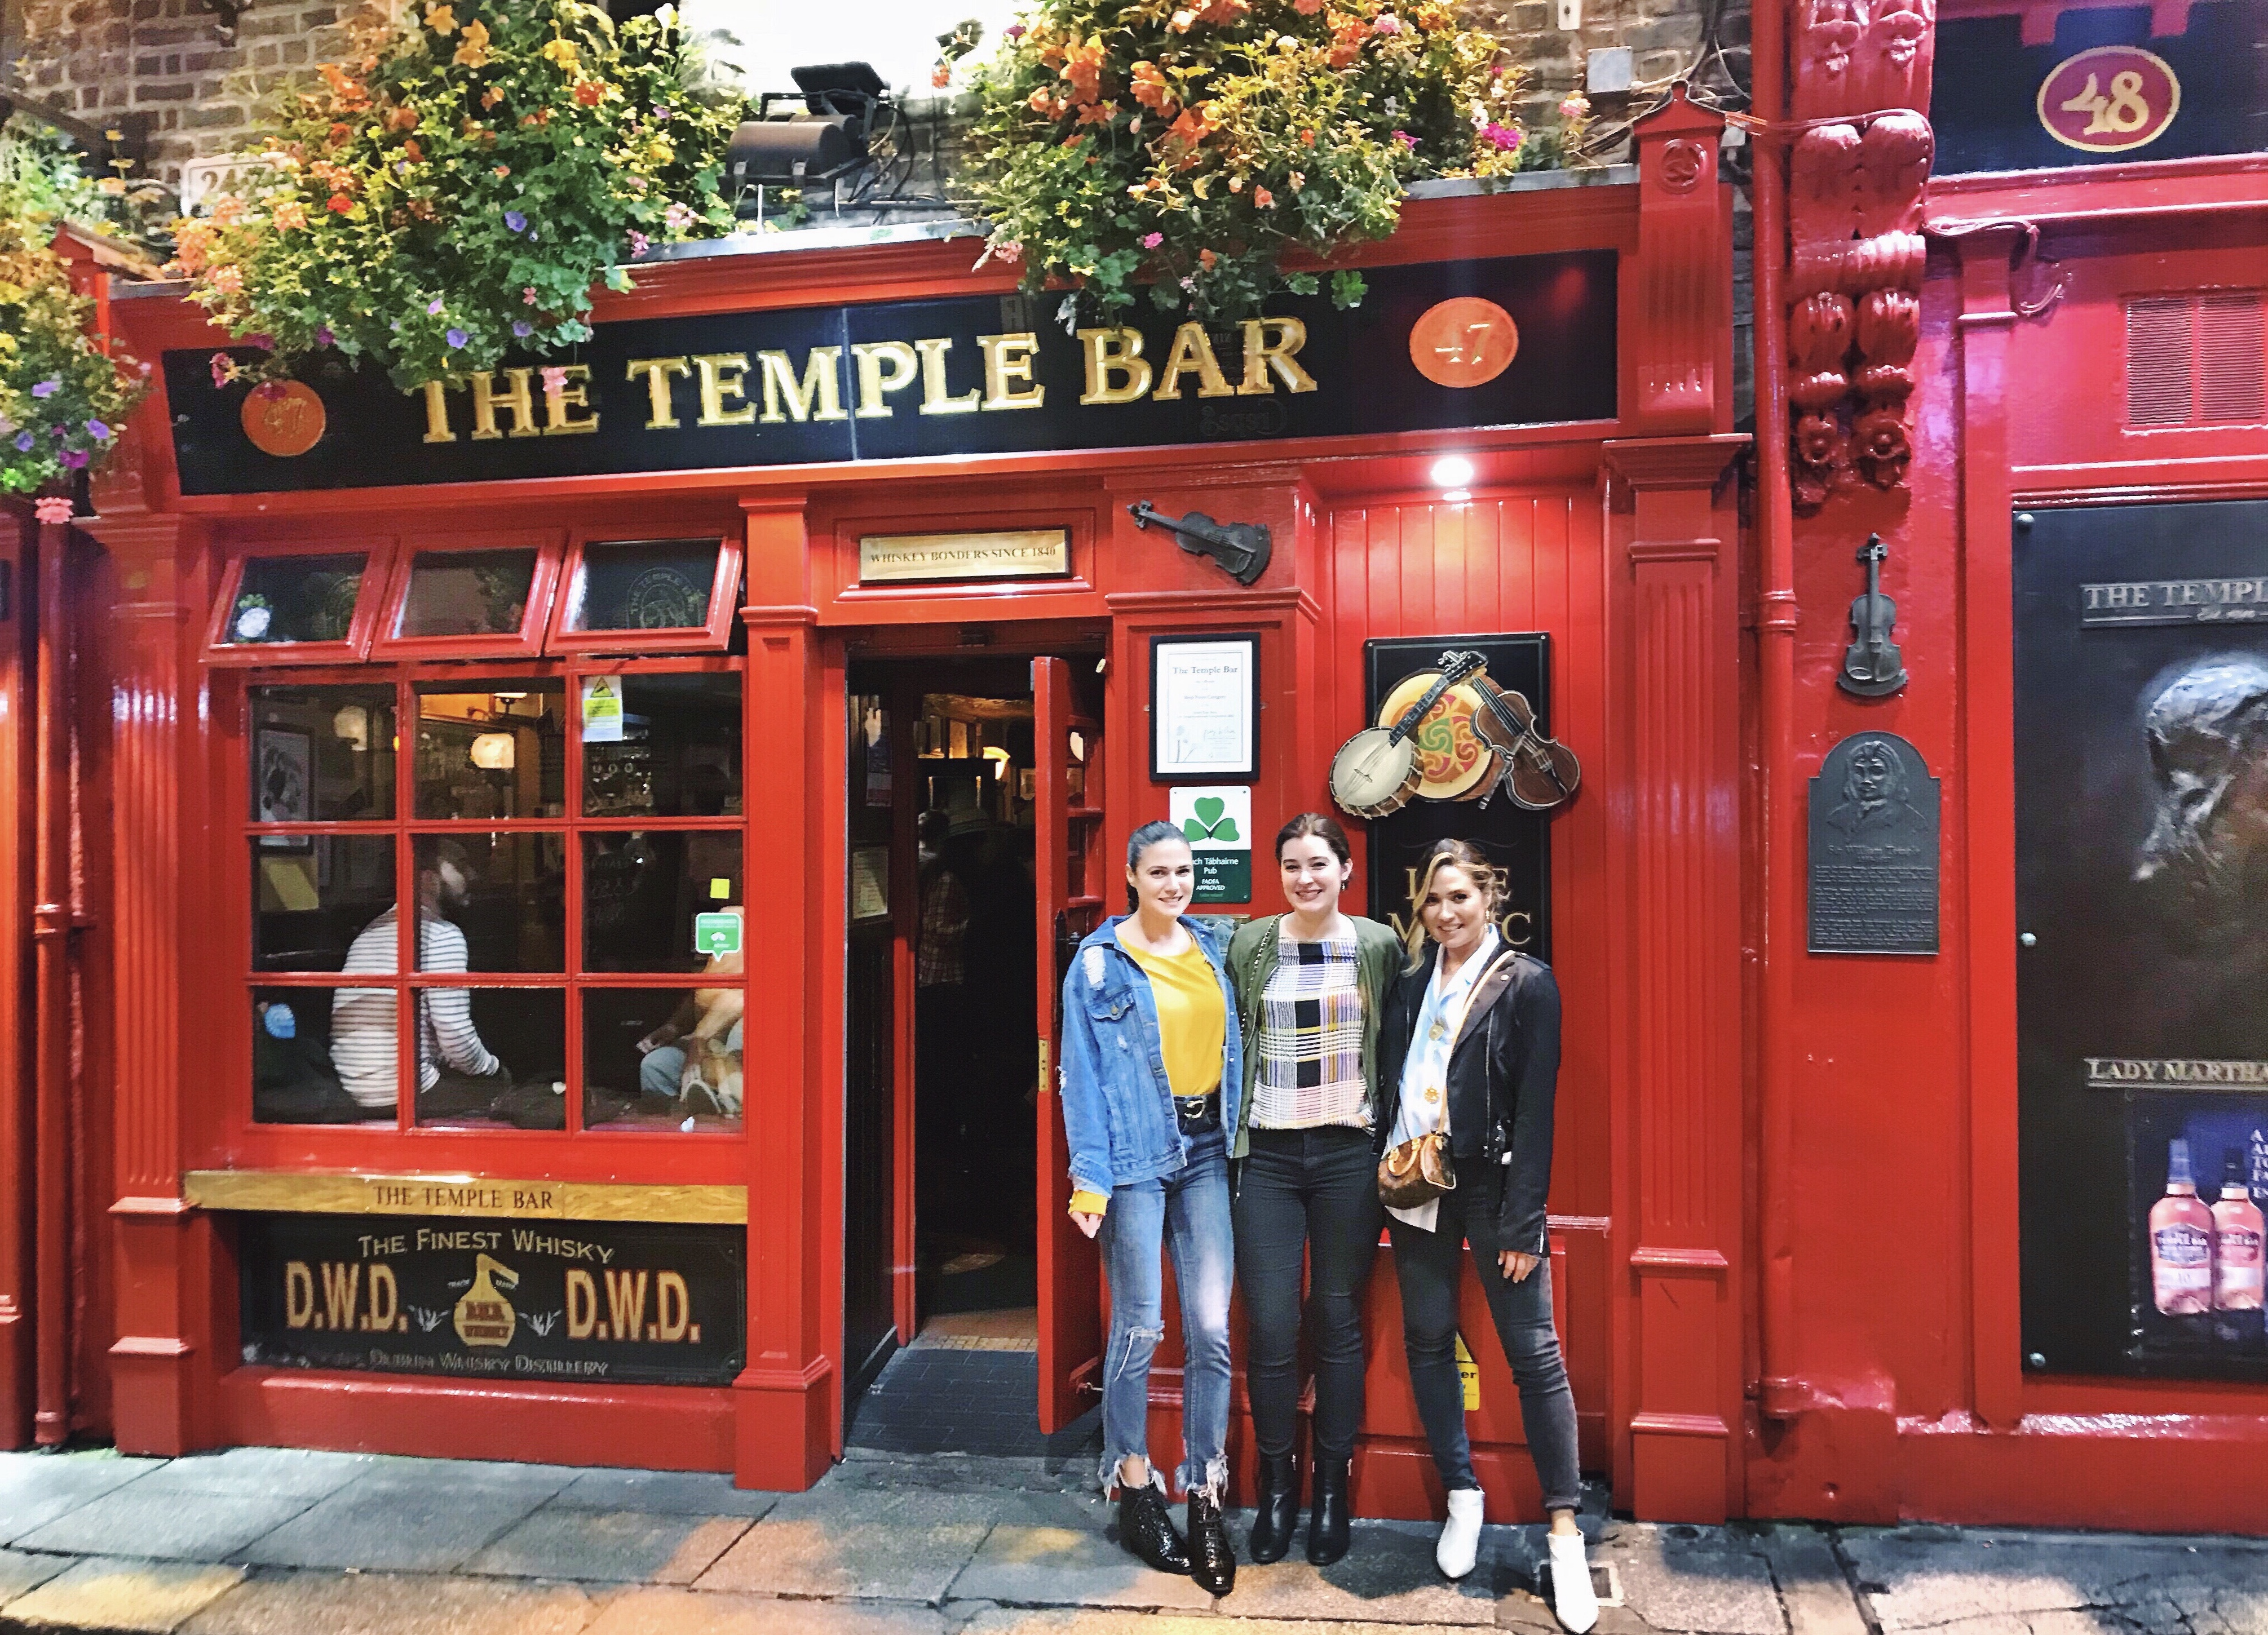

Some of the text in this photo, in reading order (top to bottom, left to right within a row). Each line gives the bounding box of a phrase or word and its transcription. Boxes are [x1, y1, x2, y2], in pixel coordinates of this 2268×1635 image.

[2061, 70, 2149, 136] 48
[1435, 319, 1494, 365] 47
[625, 332, 1046, 430] TEMPLE
[1076, 316, 1318, 405] BAR
[870, 546, 1056, 564] WHISKEY BONDERS SINCE 1840
[2085, 580, 2268, 609] THE TEMPL
[1191, 666, 1221, 676] Temple
[1203, 866, 1218, 875] Pub
[2087, 1060, 2160, 1080] LADY
[373, 1186, 553, 1209] THE TEMPLE BAR
[358, 1228, 614, 1264] THE FINEST WHISKY
[285, 1260, 701, 1344] D.W.D. D.W.D.
